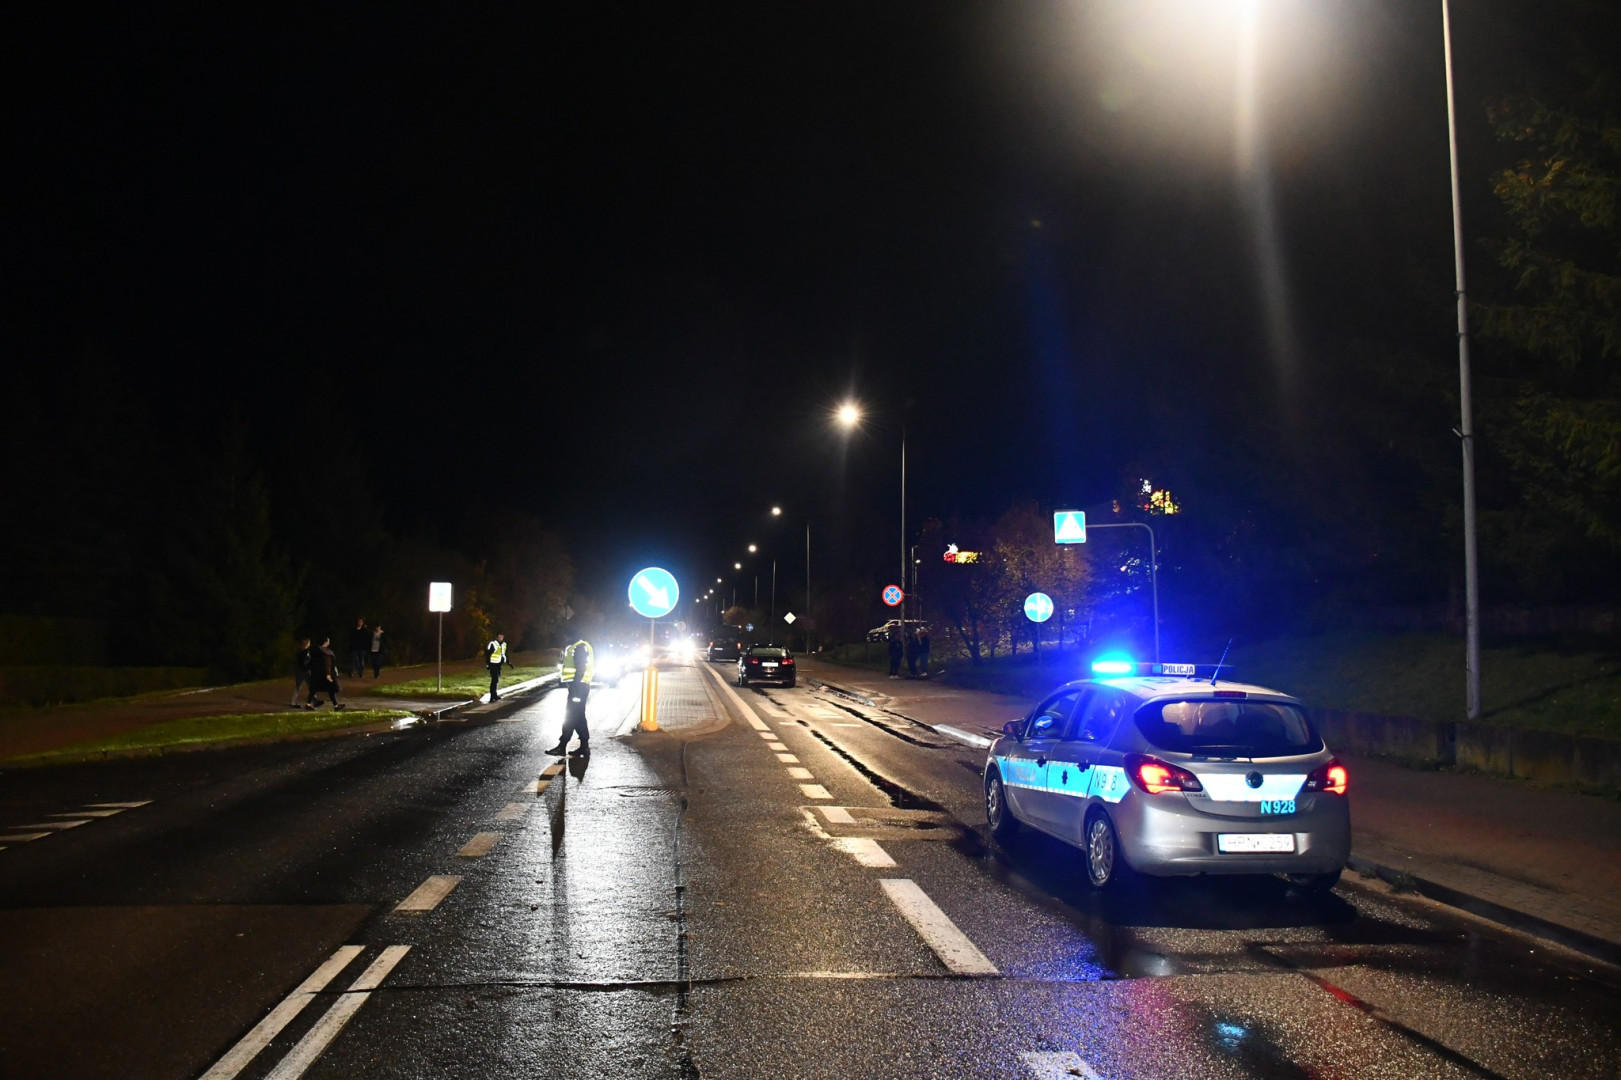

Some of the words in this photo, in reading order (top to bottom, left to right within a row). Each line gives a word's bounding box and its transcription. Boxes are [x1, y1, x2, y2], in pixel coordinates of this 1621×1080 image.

[1163, 664, 1194, 674] POLICJA
[1094, 771, 1118, 791] N98
[1260, 800, 1296, 814] N928
